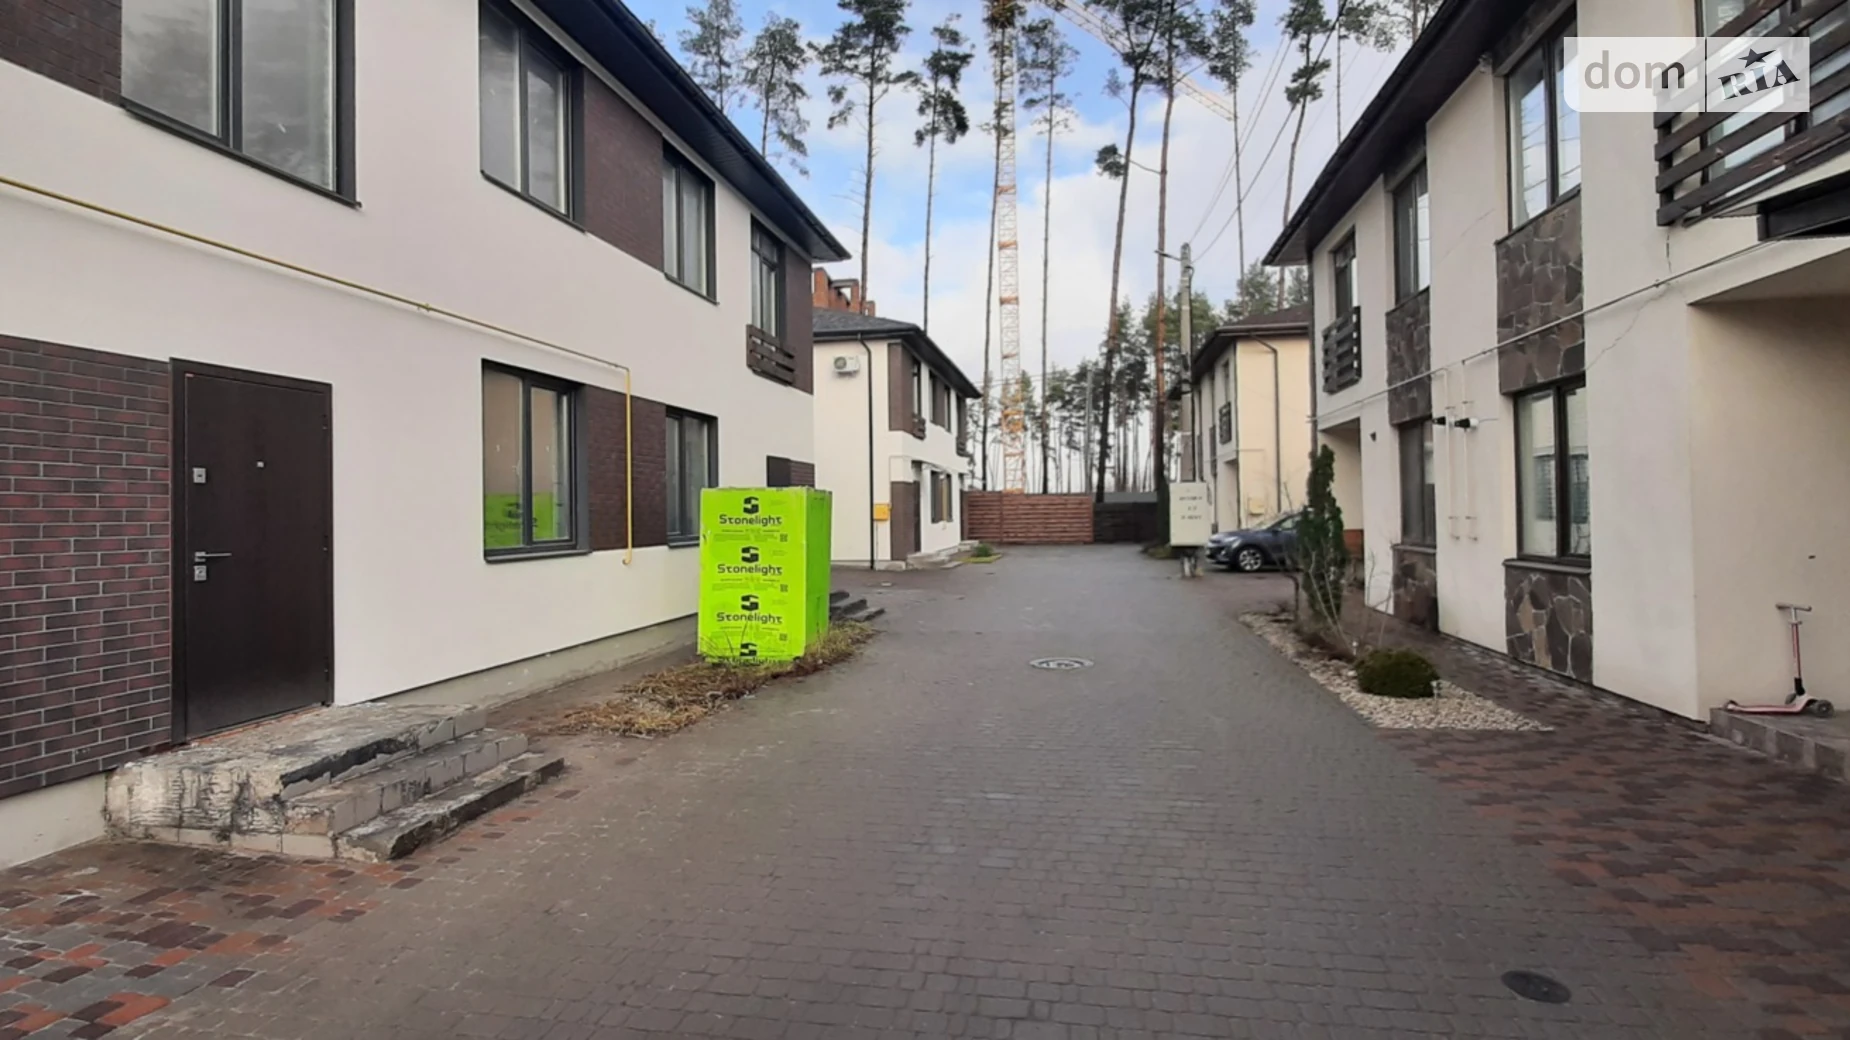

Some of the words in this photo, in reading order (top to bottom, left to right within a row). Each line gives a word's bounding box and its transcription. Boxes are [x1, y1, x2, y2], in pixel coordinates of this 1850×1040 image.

[719, 514, 782, 526] Stonelight
[717, 564, 782, 576] Stonelight
[716, 612, 782, 624] Stonelight
